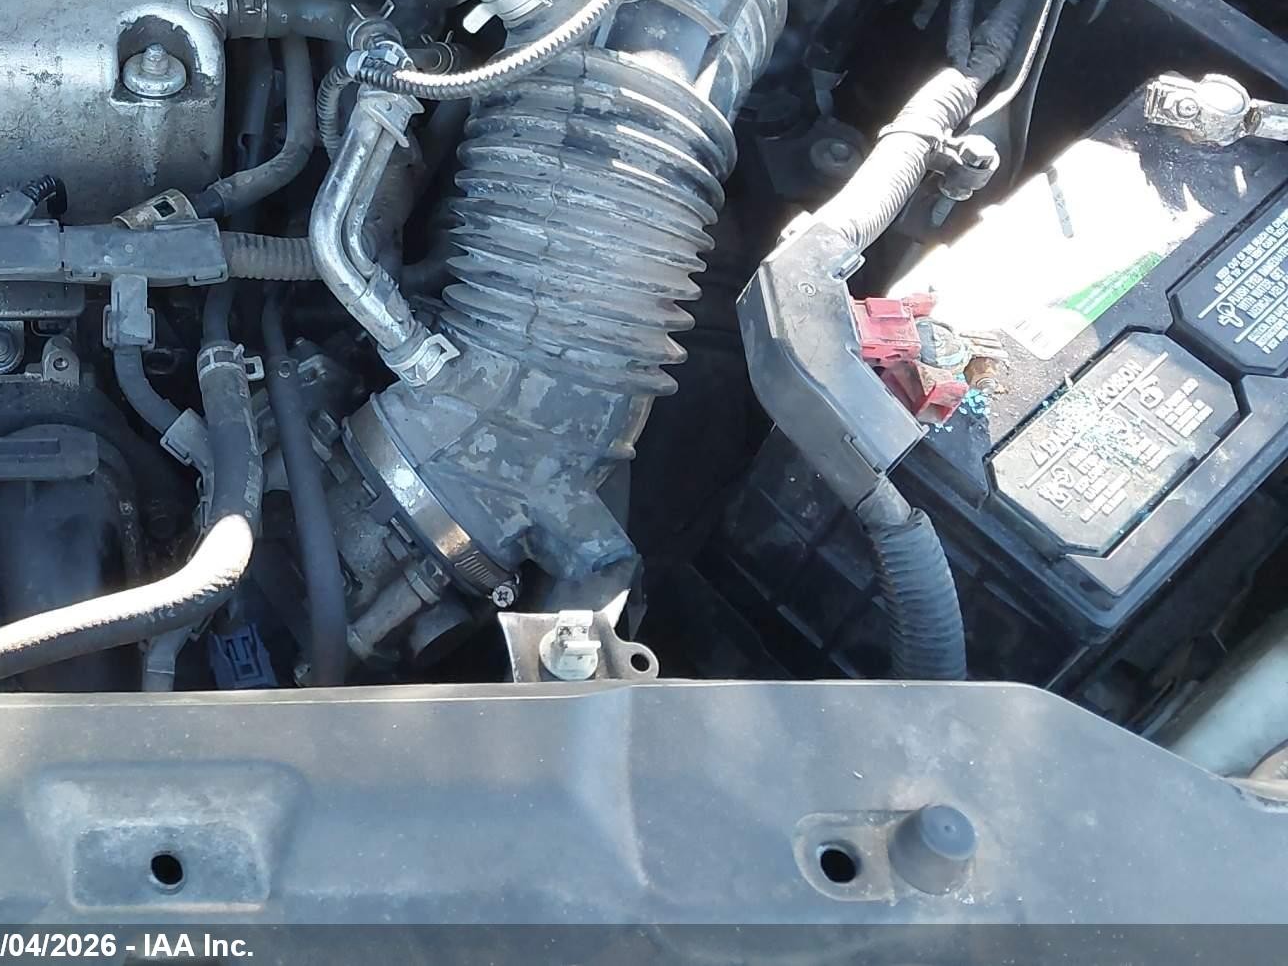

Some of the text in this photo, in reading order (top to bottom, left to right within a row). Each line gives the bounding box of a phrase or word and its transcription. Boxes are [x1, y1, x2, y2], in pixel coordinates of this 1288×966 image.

[1226, 284, 1250, 305] FLUSH
[1242, 272, 1263, 289] EYES
[1237, 294, 1256, 312] WITH
[1246, 295, 1274, 319] MEDICAL
